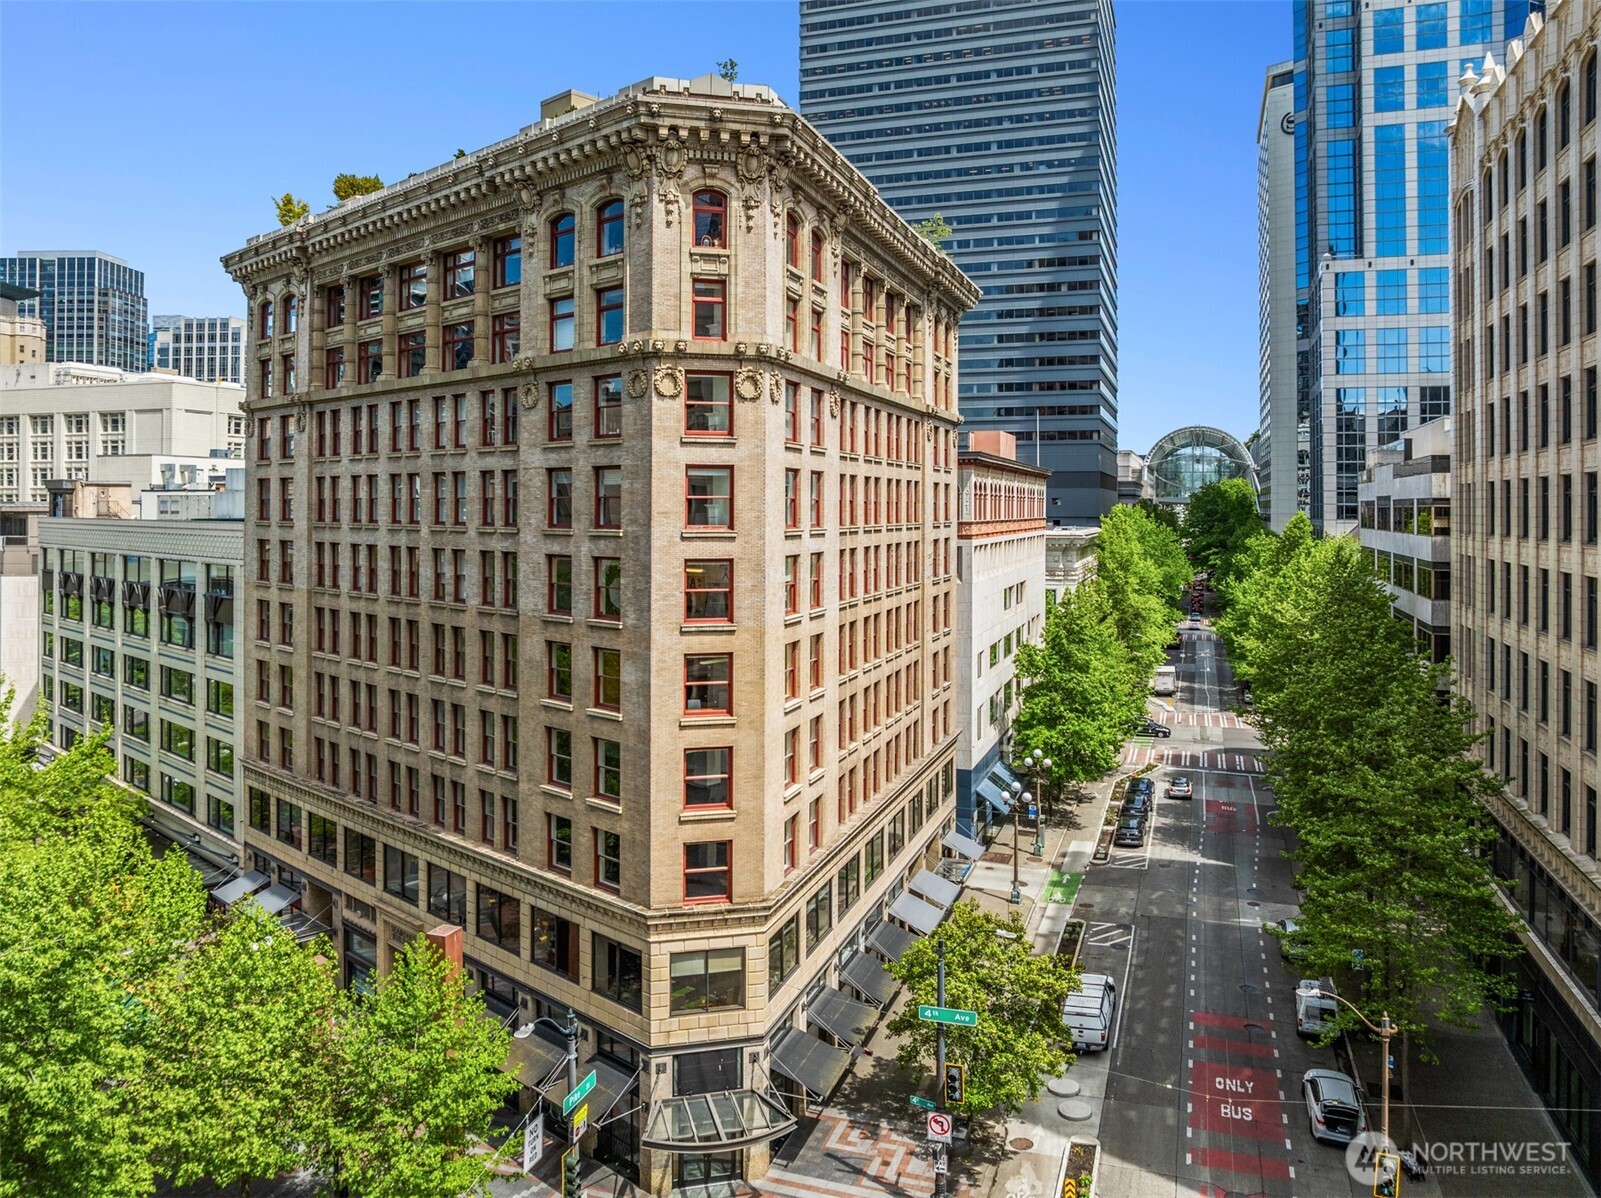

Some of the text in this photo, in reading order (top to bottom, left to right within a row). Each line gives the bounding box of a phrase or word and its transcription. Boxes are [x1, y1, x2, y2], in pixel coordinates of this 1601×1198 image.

[954, 1014, 970, 1022] Ave
[1215, 1077, 1254, 1093] ONLY
[569, 1091, 580, 1106] Pike
[1221, 1104, 1252, 1121] BUS
[529, 1123, 538, 1138] NO
[530, 1144, 537, 1154] ON
[529, 1152, 537, 1164] RED
